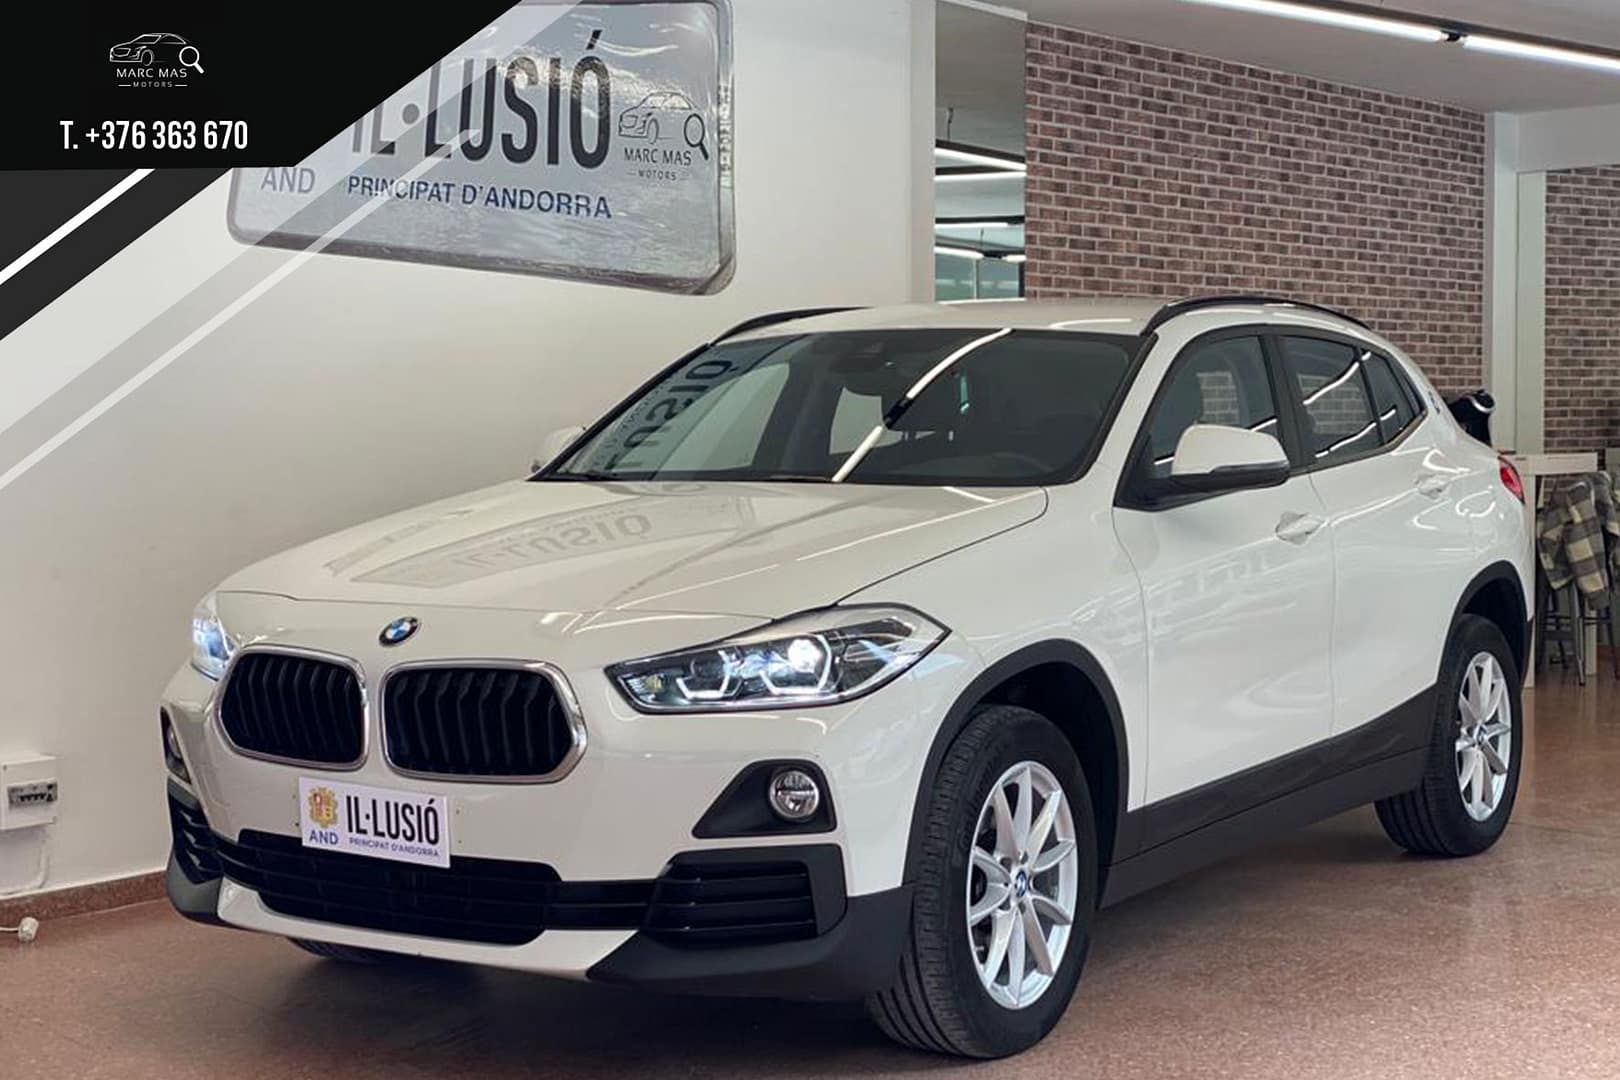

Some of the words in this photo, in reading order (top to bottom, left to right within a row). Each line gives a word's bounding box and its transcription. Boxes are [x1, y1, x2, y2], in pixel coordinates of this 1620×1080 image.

[624, 147, 658, 163] MARC
[662, 150, 692, 166] MAS
[261, 167, 316, 194] AND
[348, 175, 456, 205] PRINCIPAT
[461, 184, 612, 219] D'ANDORRA
[346, 795, 440, 846] IL·LUSIÓ
[309, 829, 339, 846] AND
[349, 836, 389, 850] PRINCIPAT
